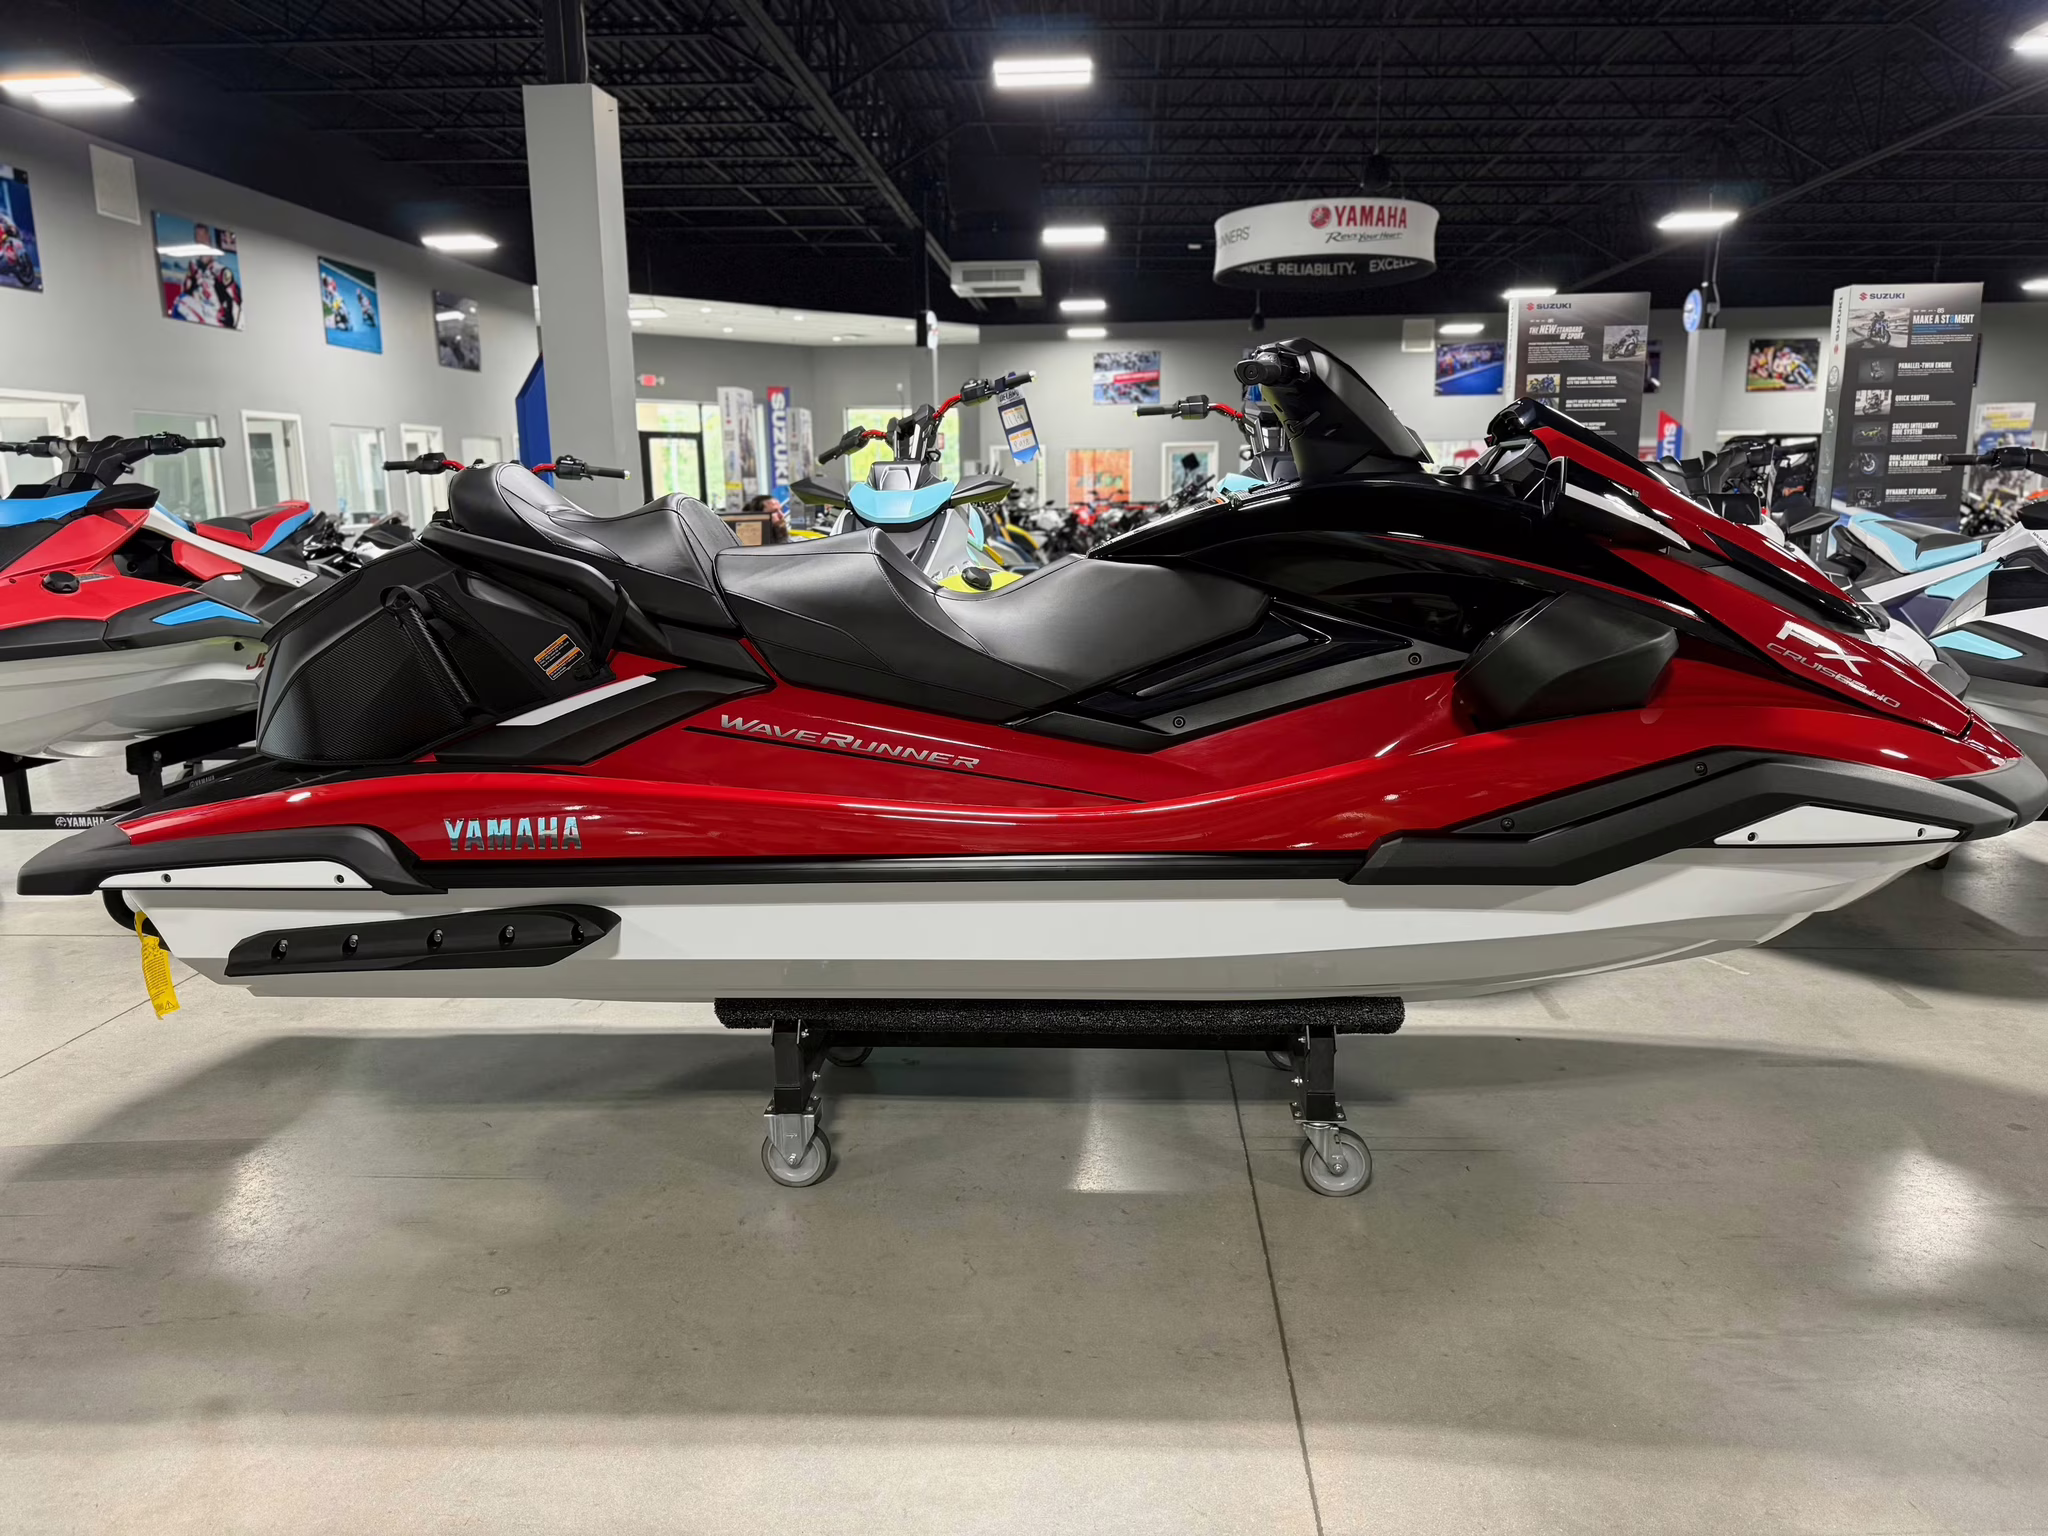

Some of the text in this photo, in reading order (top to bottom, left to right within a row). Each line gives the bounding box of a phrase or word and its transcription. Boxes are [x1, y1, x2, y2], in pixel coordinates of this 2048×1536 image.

[1334, 205, 1407, 228] YAMAHA
[1277, 261, 1357, 276] RELIABILITY.
[1870, 292, 1905, 300] SUZUKI
[1536, 302, 1572, 310] SUZUKI
[1834, 297, 1844, 342] SUZUKI
[1912, 315, 1934, 325] MAKE
[1934, 315, 1940, 324] A
[1529, 324, 1583, 334] THE NEW STANDARD
[1567, 332, 1585, 340] SPORT
[1935, 361, 1952, 369] ENGINE
[770, 391, 789, 486] SUZUKI
[1776, 621, 1871, 677] FX
[67, 816, 105, 828] YAMAHA
[443, 817, 582, 851] YAMAHA
